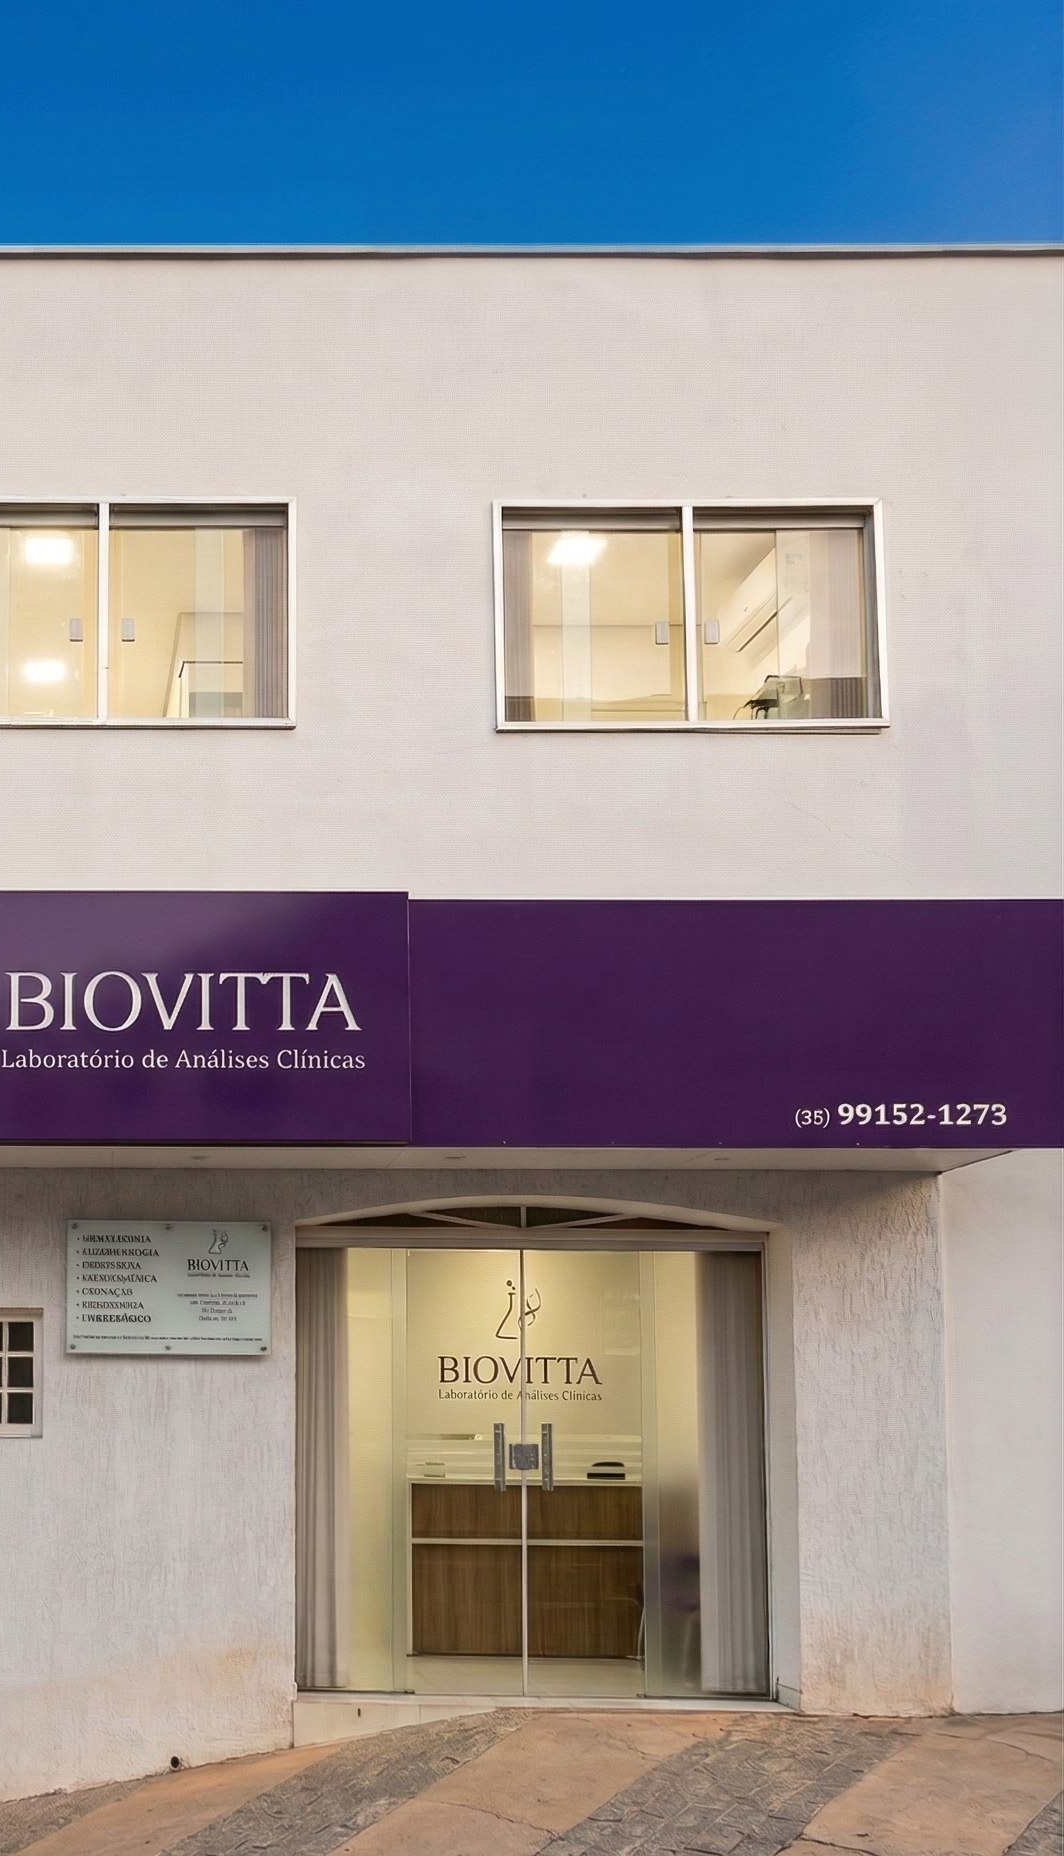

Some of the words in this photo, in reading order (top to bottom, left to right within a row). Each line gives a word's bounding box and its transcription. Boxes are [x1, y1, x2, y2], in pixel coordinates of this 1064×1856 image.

[5, 970, 362, 1032] BIOVITTA
[1, 1049, 134, 1069] Laboratório
[141, 1049, 169, 1069] de
[175, 1049, 269, 1069] Análises
[276, 1049, 366, 1069] Clínicas
[794, 1108, 831, 1129] (35)
[837, 1103, 1008, 1126] 99152-1273
[187, 1258, 249, 1272] BIOVITTA
[438, 1356, 603, 1385] BIOVITTA
[438, 1389, 499, 1400] Laboratório
[501, 1389, 514, 1400] de
[562, 1390, 603, 1402] Clínicas
